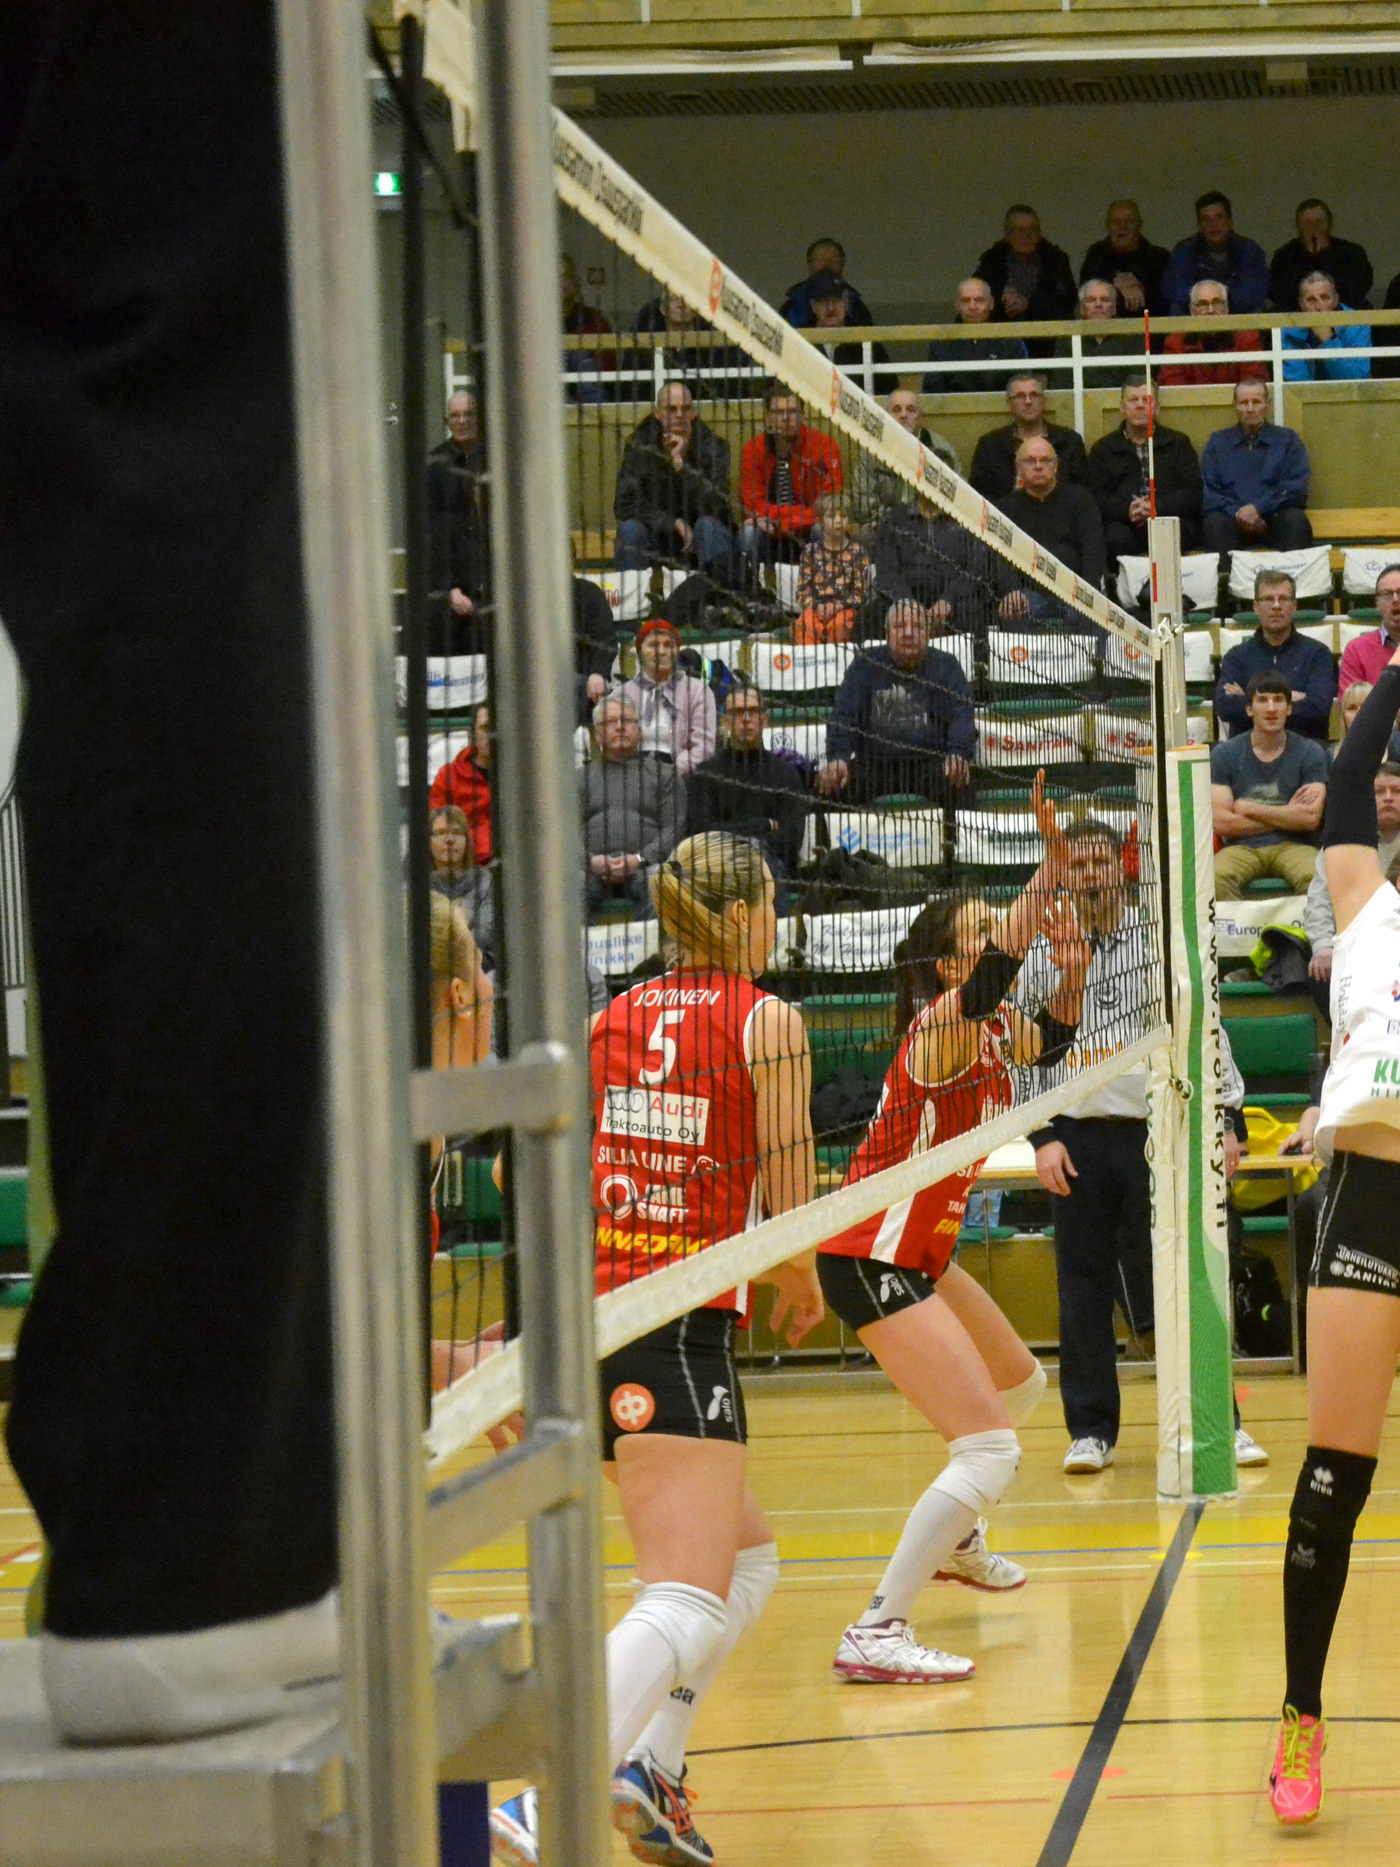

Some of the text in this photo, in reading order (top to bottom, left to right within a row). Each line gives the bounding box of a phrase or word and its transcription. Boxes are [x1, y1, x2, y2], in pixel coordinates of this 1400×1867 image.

[633, 988, 722, 1008] JOKINEN
[638, 1008, 687, 1086] 5
[649, 1095, 704, 1120] Audi
[677, 1126, 700, 1143] Oy
